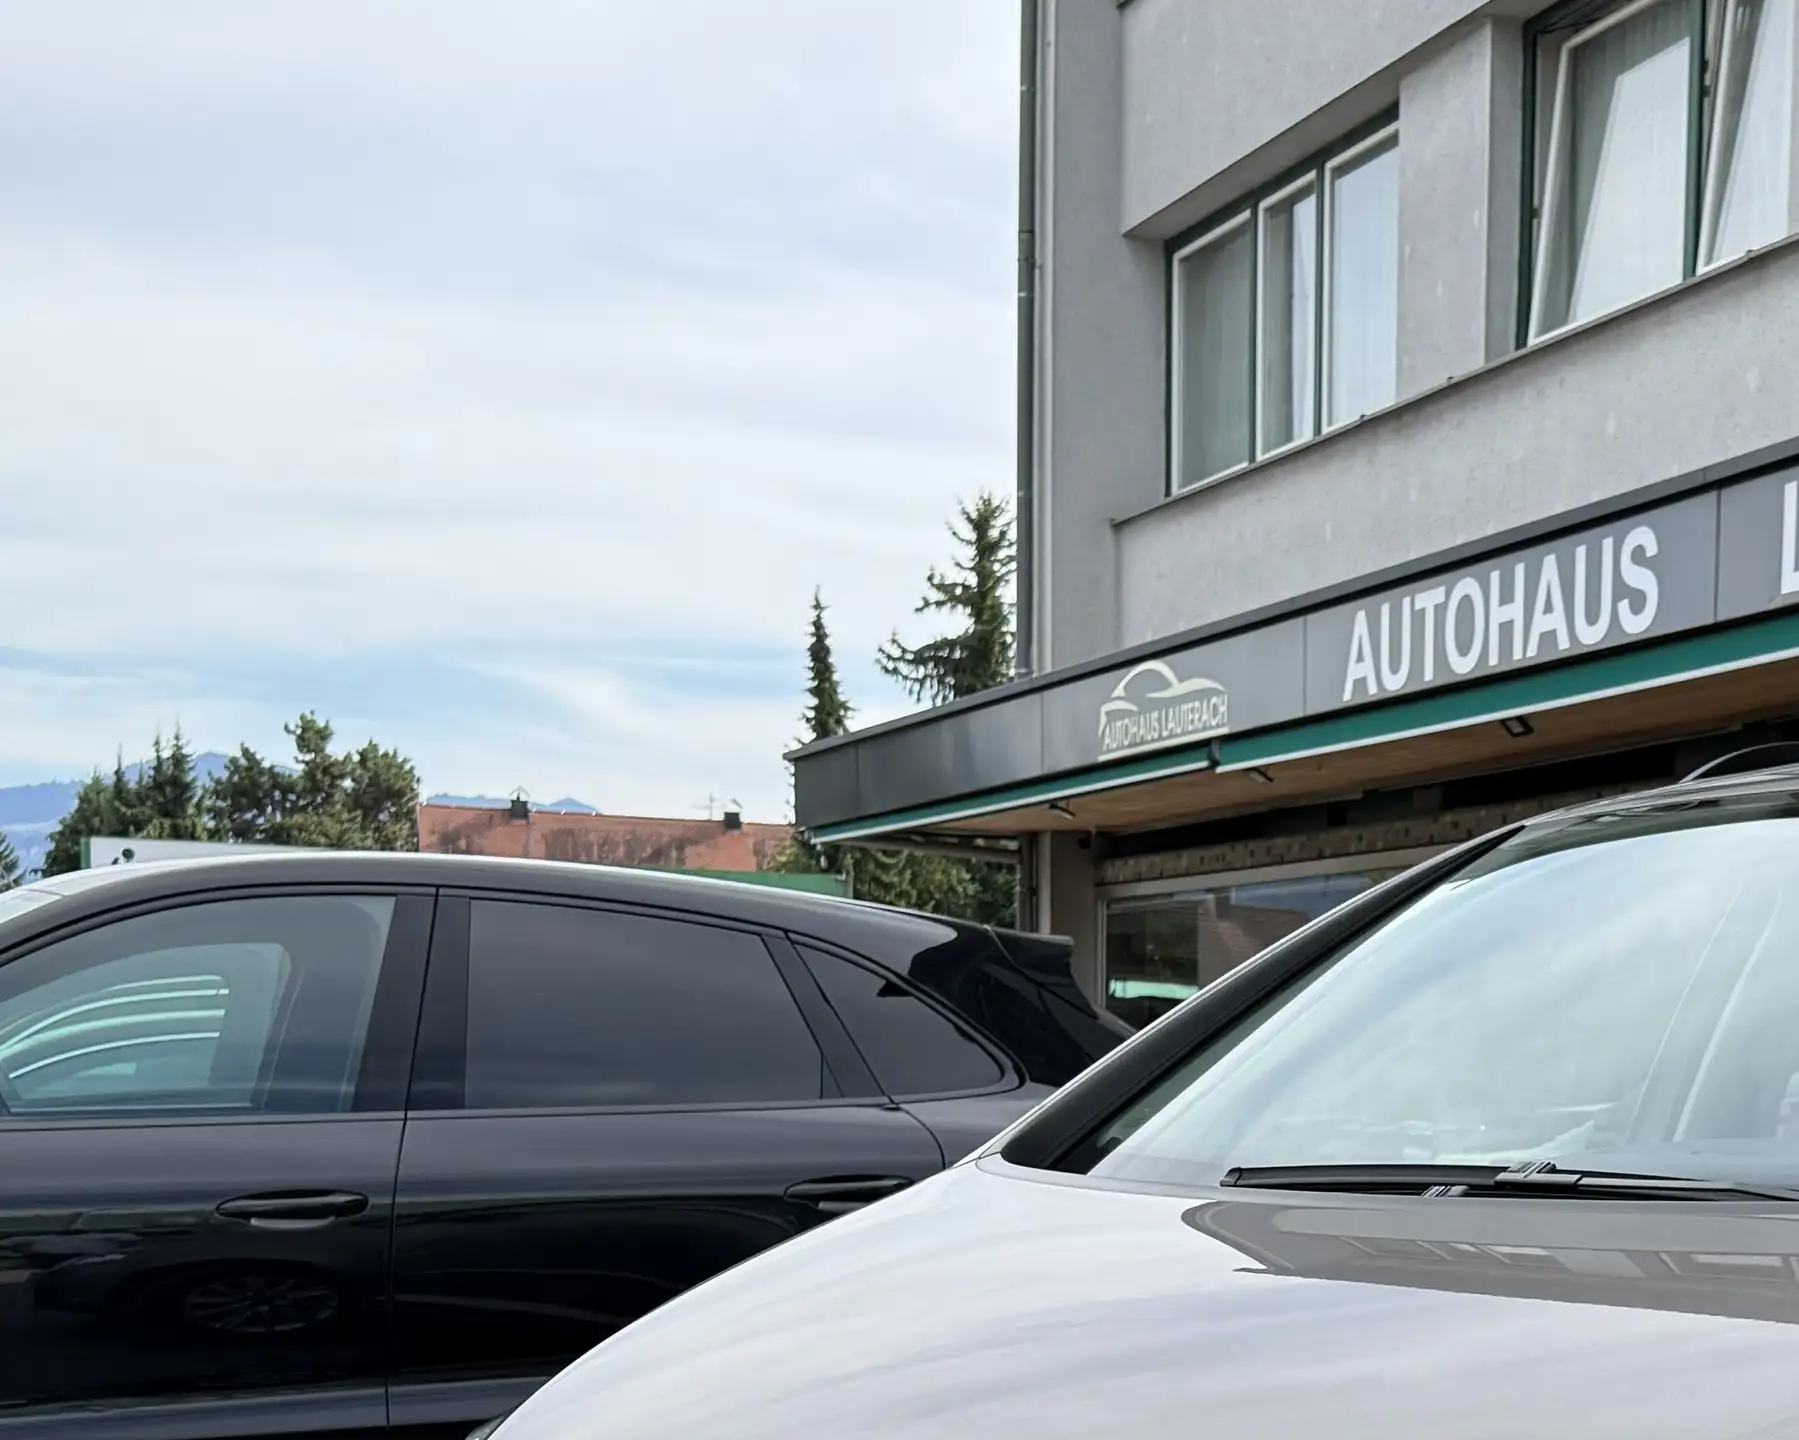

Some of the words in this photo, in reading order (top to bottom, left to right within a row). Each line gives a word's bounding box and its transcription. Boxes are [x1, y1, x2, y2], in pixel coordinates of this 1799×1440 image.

[1341, 524, 1661, 703] AUTOHAUS
[1103, 709, 1160, 751] AUTOHAUS
[1161, 693, 1229, 737] LAUTERACH
